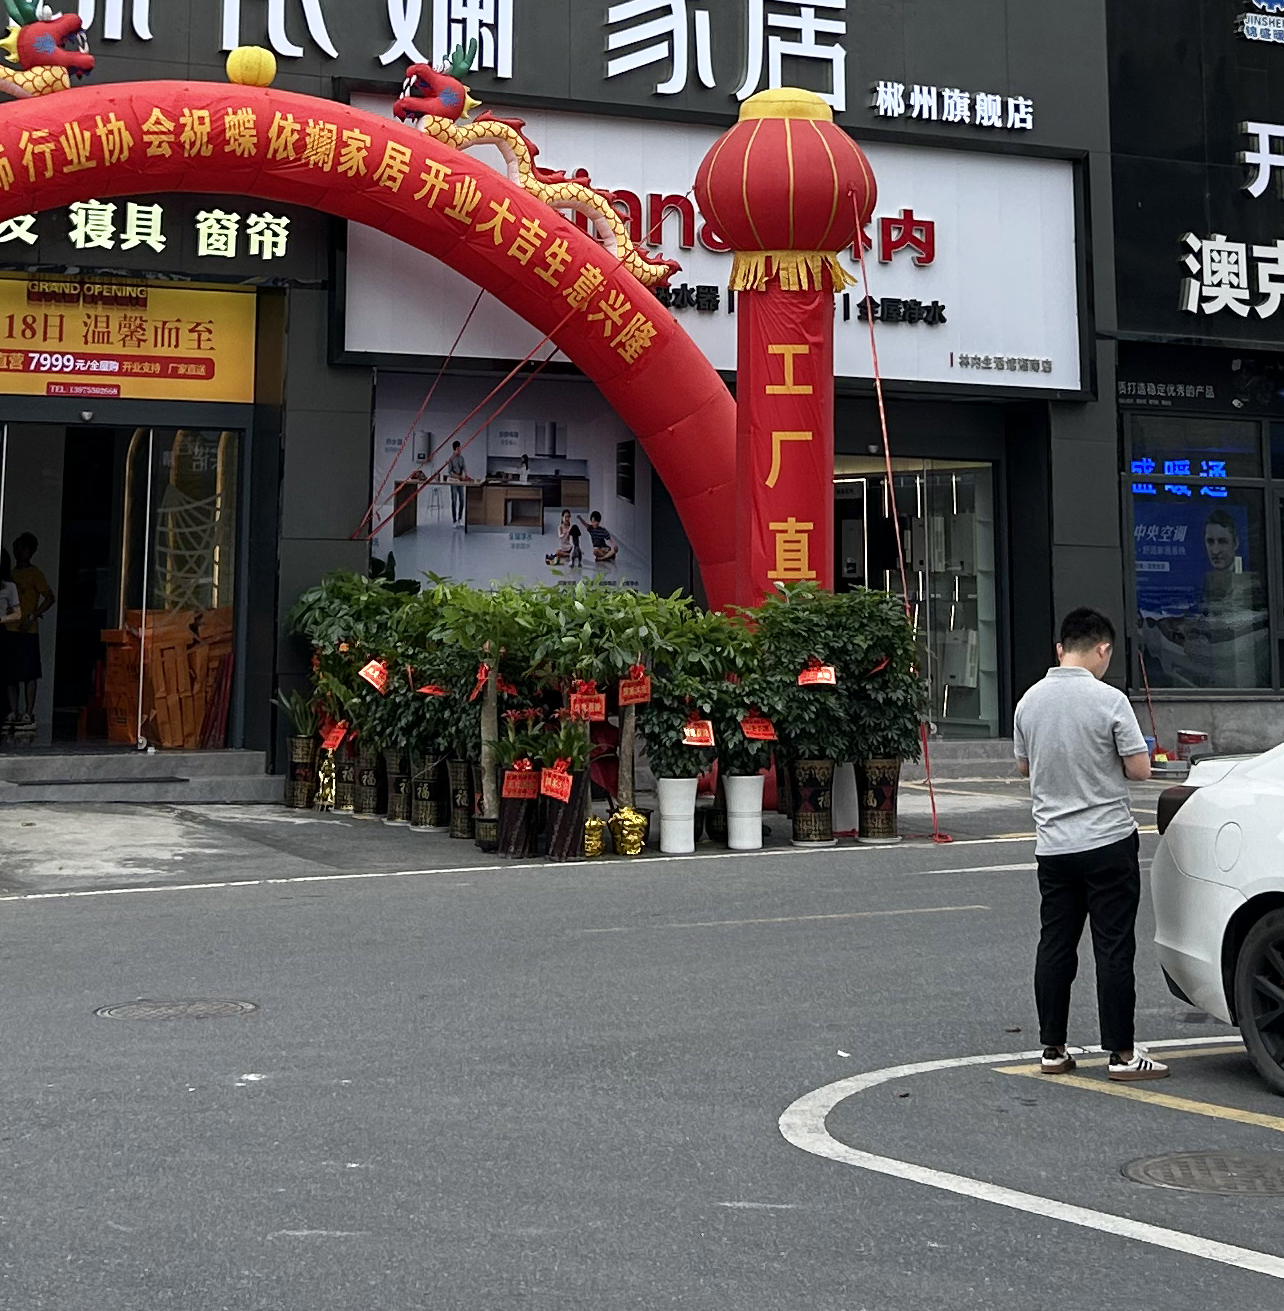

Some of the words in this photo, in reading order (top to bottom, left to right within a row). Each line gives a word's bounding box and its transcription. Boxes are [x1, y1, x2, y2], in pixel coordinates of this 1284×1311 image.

[872, 78, 1034, 129] 郴州旗舰店
[68, 198, 167, 253] 寝具
[194, 208, 292, 261] 窗帘
[27, 280, 81, 295] GRAND
[83, 282, 149, 299] OPENING
[82, 311, 217, 352] 温馨而至
[122, 360, 161, 374] 开业支持
[1134, 523, 1188, 542] 中央空调
